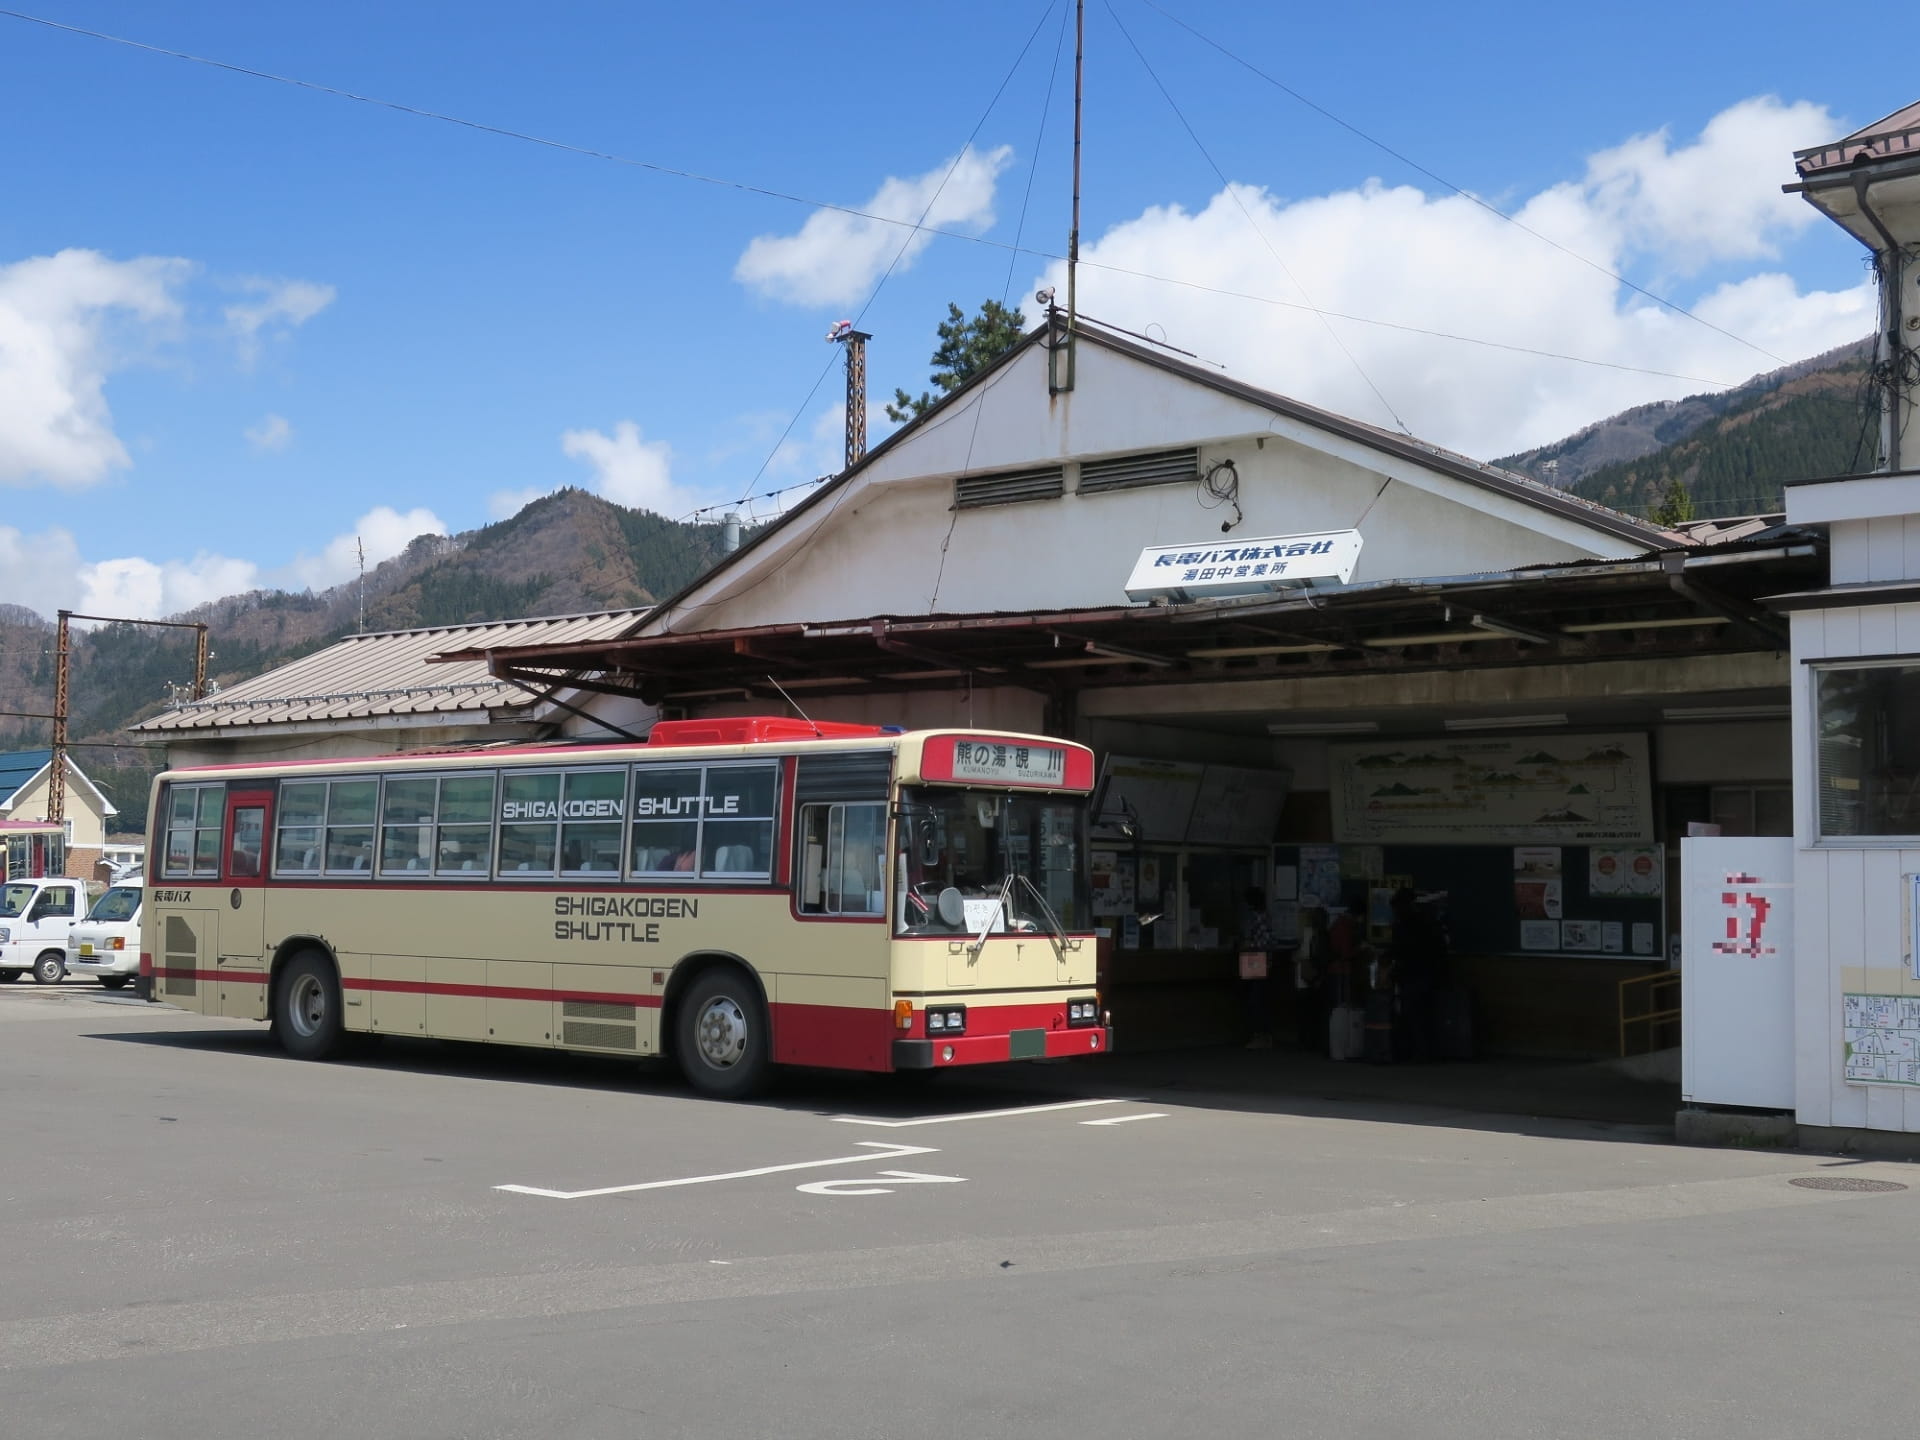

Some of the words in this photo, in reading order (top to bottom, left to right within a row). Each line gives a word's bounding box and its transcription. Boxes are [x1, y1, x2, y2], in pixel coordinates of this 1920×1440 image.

[1154, 540, 1334, 567] 長電バス株式会社
[1181, 562, 1288, 582] 湯田中営業所
[502, 800, 624, 818] SHIGAKOGEN
[638, 796, 740, 814] SHUTTLE
[154, 890, 192, 902] 長電バス
[554, 896, 698, 918] SHIGAKOGEN
[554, 920, 660, 943] SHUTTLE
